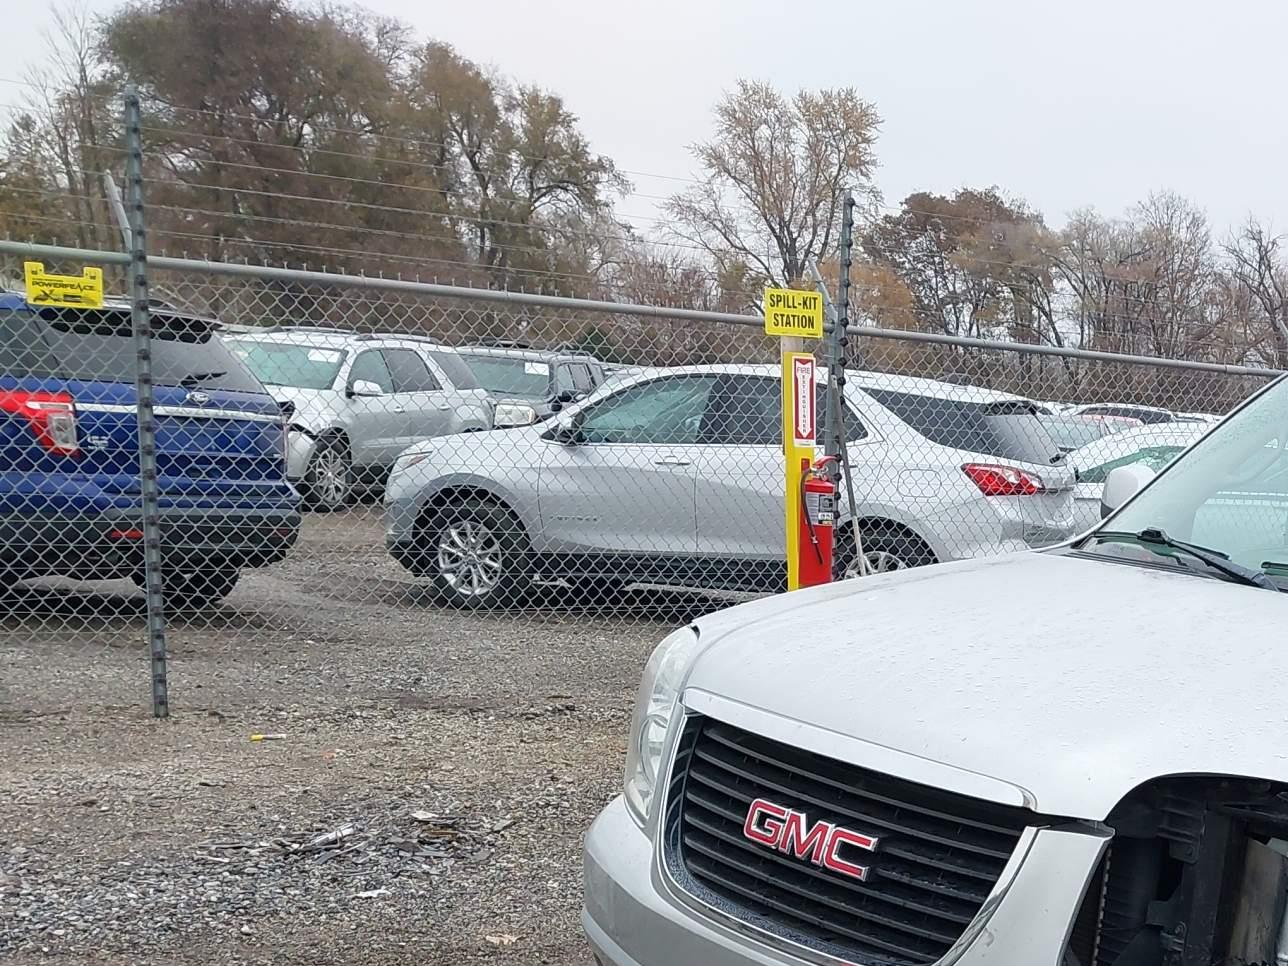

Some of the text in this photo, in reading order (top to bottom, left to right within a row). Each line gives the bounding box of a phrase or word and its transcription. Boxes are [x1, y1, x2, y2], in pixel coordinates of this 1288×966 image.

[769, 293, 818, 310] SPILL-KIT
[773, 312, 815, 329] STATION
[797, 366, 810, 375] FIRE
[743, 798, 879, 882] GMC
